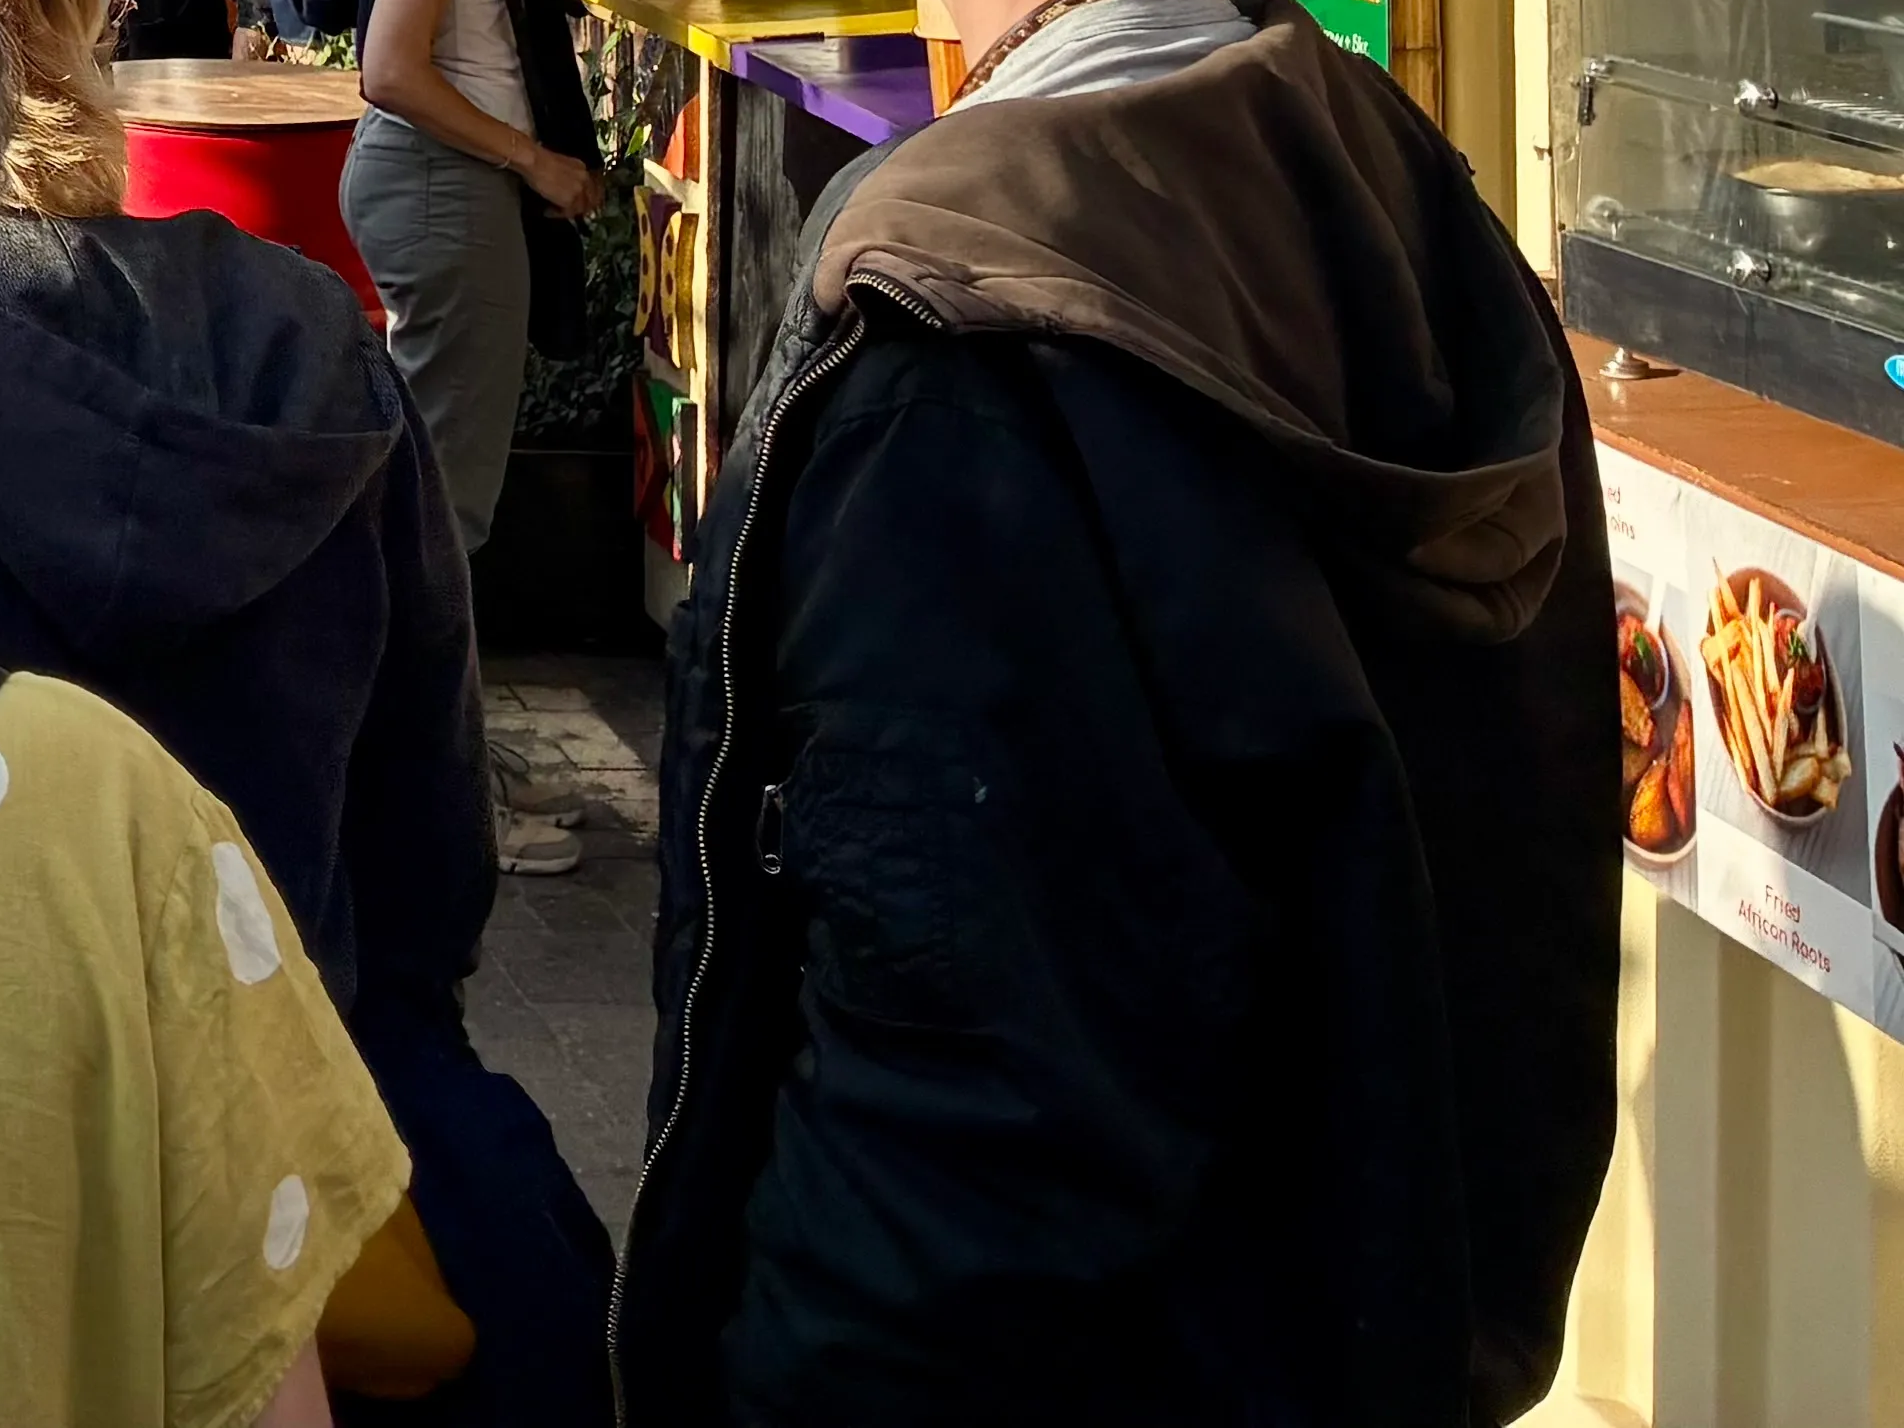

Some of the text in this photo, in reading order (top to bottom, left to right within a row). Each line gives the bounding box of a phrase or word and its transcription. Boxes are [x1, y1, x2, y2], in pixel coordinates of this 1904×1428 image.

[1765, 884, 1801, 923] Fried
[1739, 900, 1831, 973] African Roots
